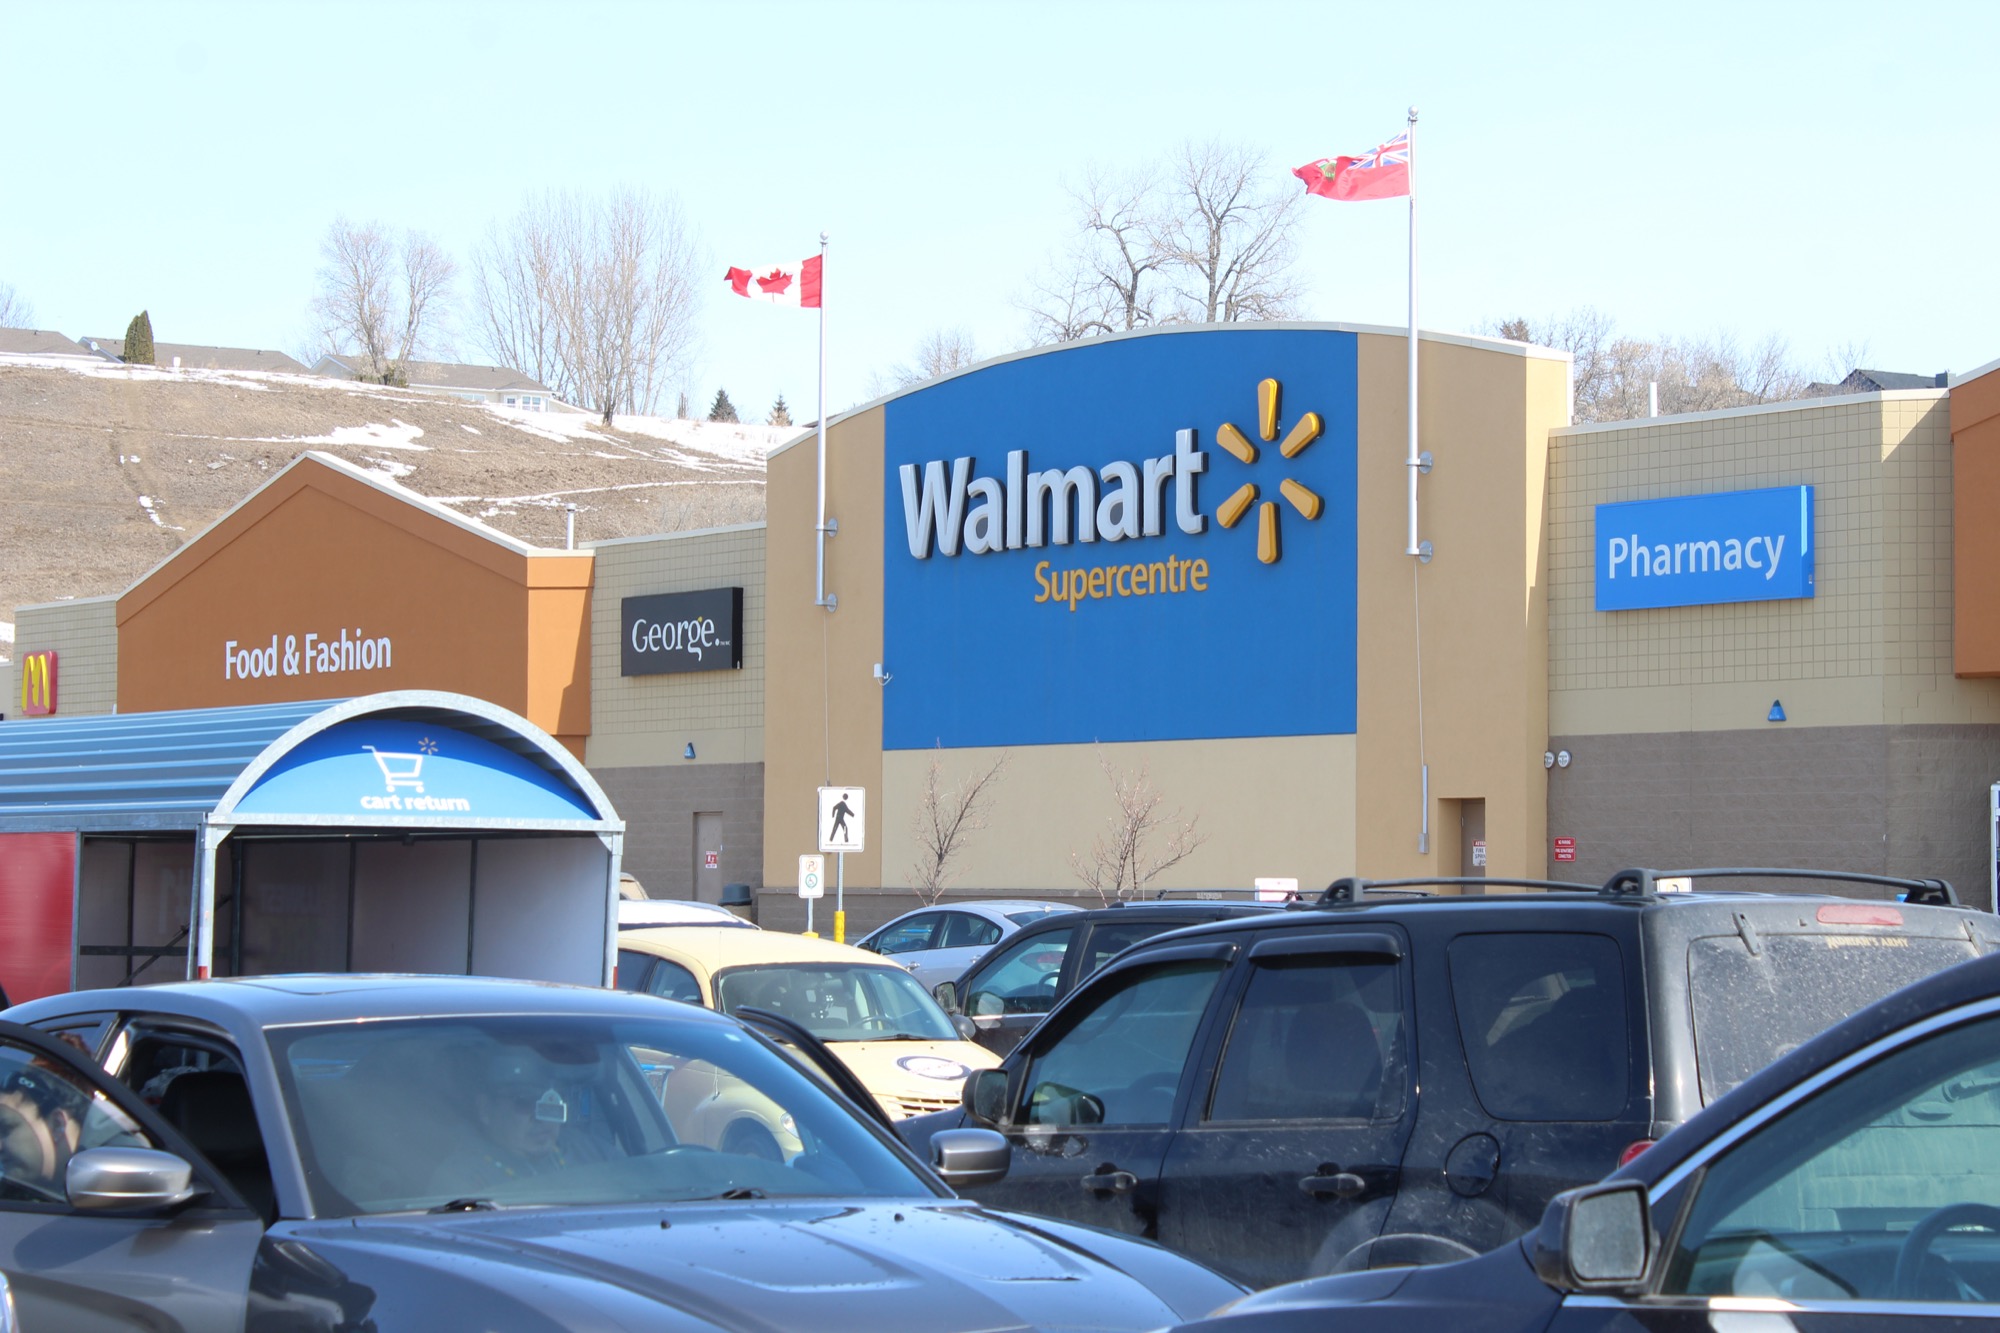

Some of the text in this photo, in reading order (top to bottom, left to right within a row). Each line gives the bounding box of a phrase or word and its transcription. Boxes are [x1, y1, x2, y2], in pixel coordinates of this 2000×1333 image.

[899, 428, 1208, 559] Walmart
[1609, 534, 1785, 581] Pharmacy
[1034, 554, 1208, 612] Supercentre
[225, 628, 392, 680] Food & Fashion
[360, 794, 470, 811] cart return
[1881, 937, 1908, 948] ARMY
